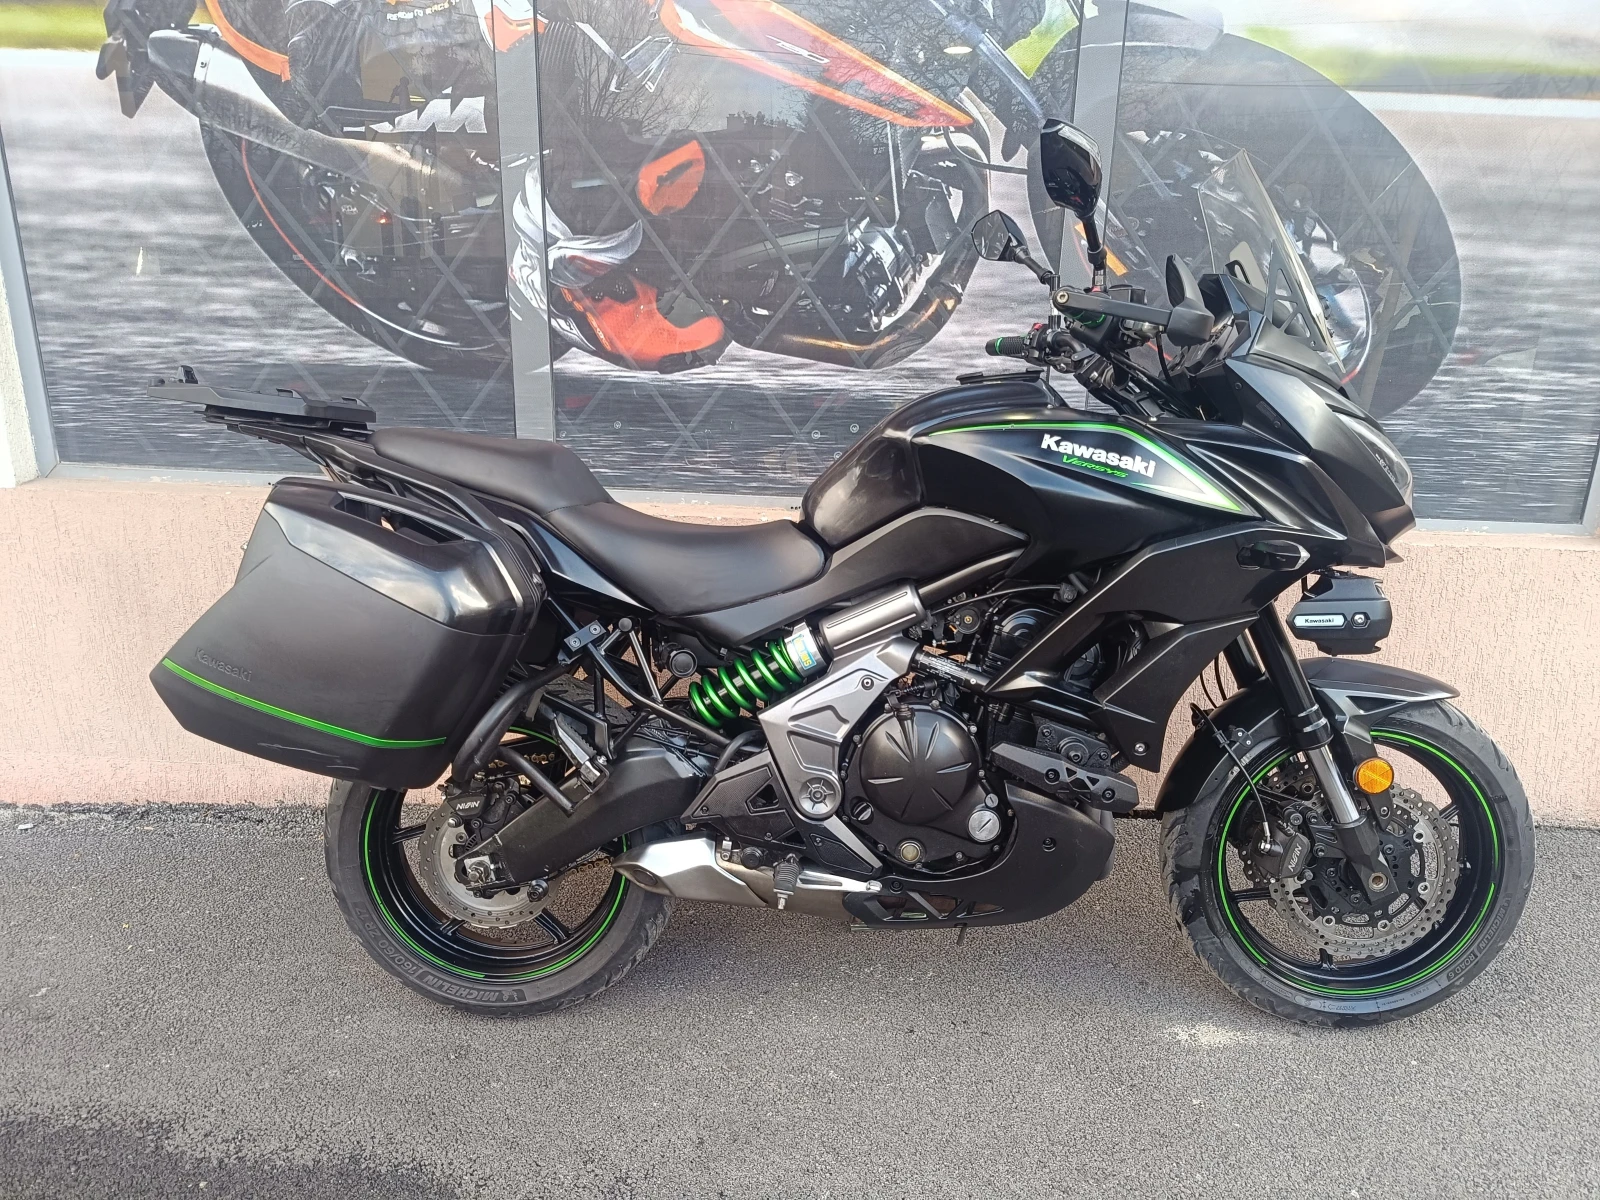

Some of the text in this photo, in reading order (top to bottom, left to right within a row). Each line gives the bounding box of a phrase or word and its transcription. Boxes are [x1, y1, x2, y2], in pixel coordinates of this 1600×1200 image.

[1041, 433, 1157, 478] Kawasaki
[195, 646, 252, 683] Kawasaki
[354, 905, 500, 1002] MICHELIN 160/60 ZR 17
[1455, 953, 1476, 974] ROAD
